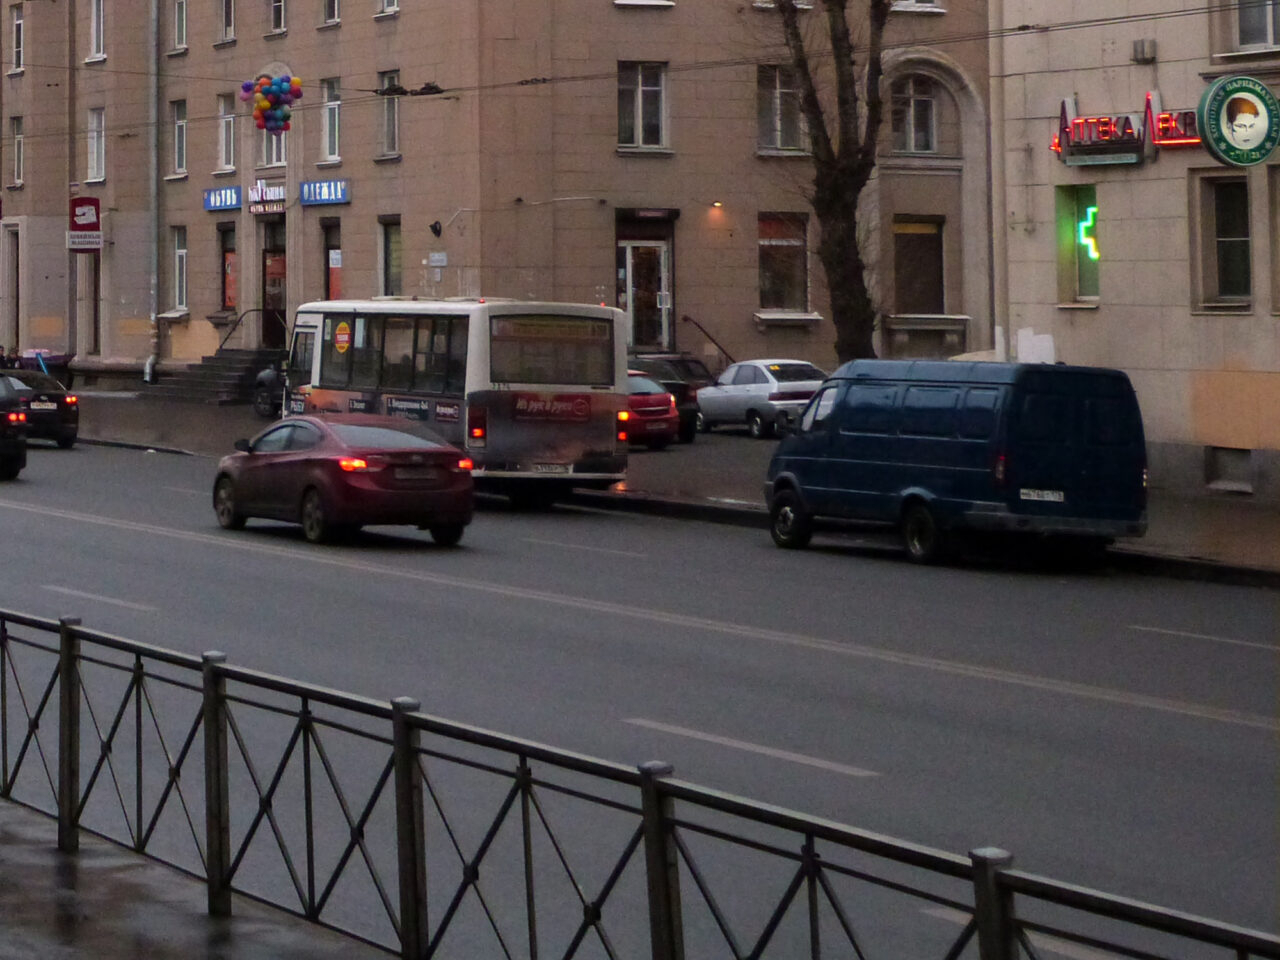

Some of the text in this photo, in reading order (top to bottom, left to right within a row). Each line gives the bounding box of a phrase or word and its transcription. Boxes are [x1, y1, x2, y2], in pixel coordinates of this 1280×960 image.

[1057, 99, 1136, 146] АПТЕКА
[210, 188, 237, 207] ОБУВЬ
[304, 181, 342, 201] ОДЕЖДА
